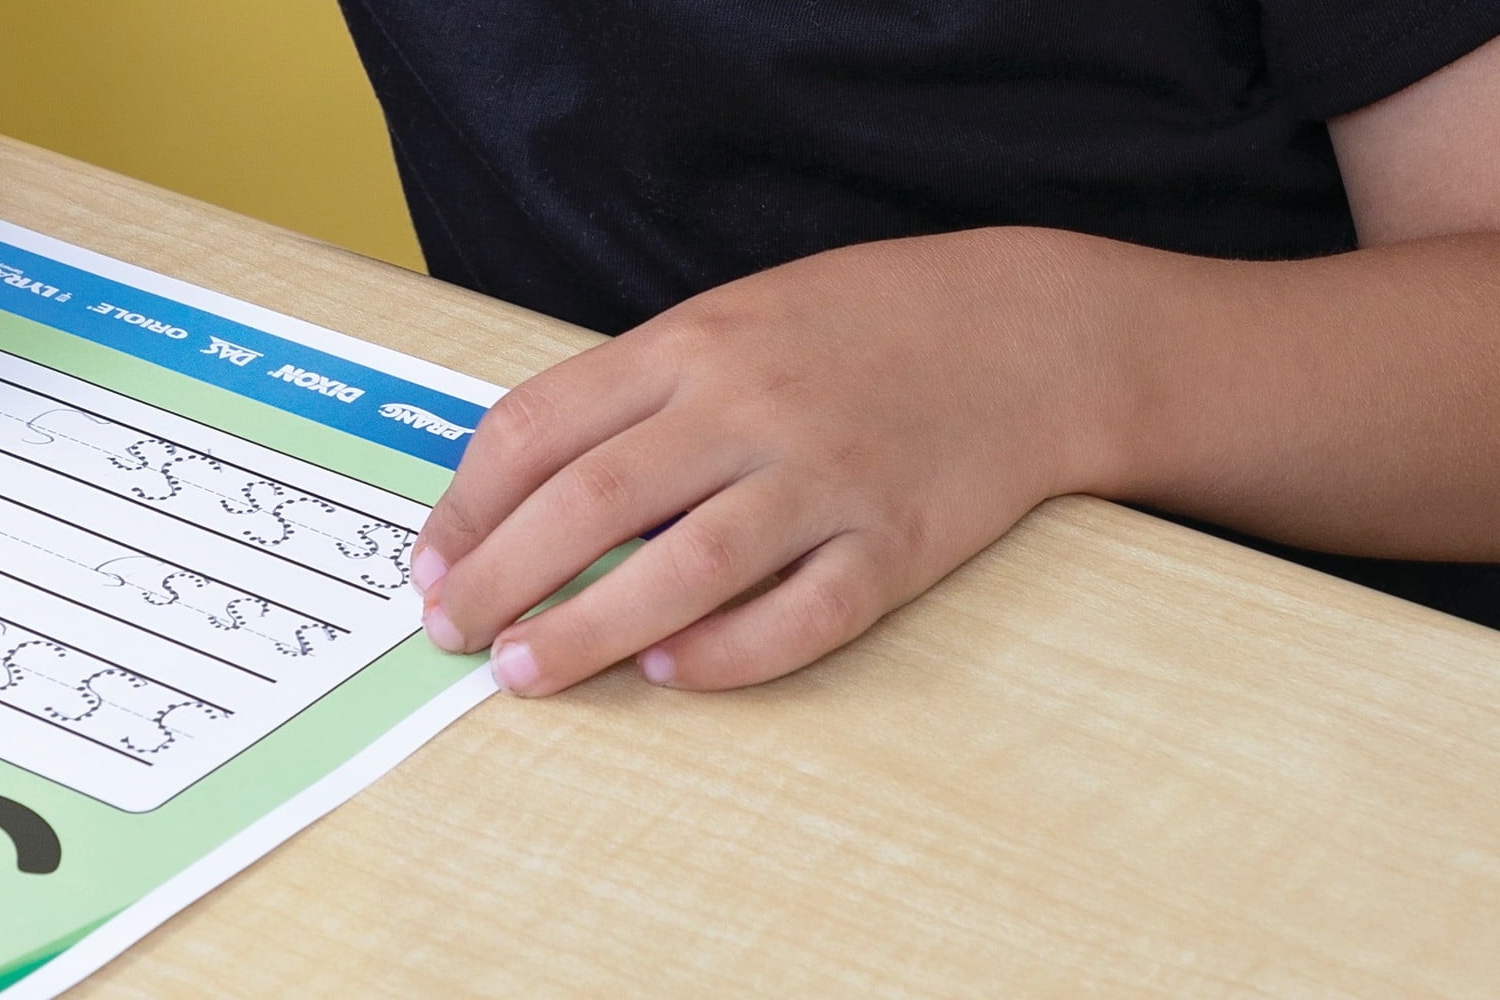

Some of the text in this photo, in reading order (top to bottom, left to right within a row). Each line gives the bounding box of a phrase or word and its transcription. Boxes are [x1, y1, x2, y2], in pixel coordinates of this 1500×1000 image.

[91, 302, 189, 341] ORIOLE
[202, 336, 264, 367] DAS
[272, 363, 366, 404] DIXON
[379, 403, 472, 441] PRANG
